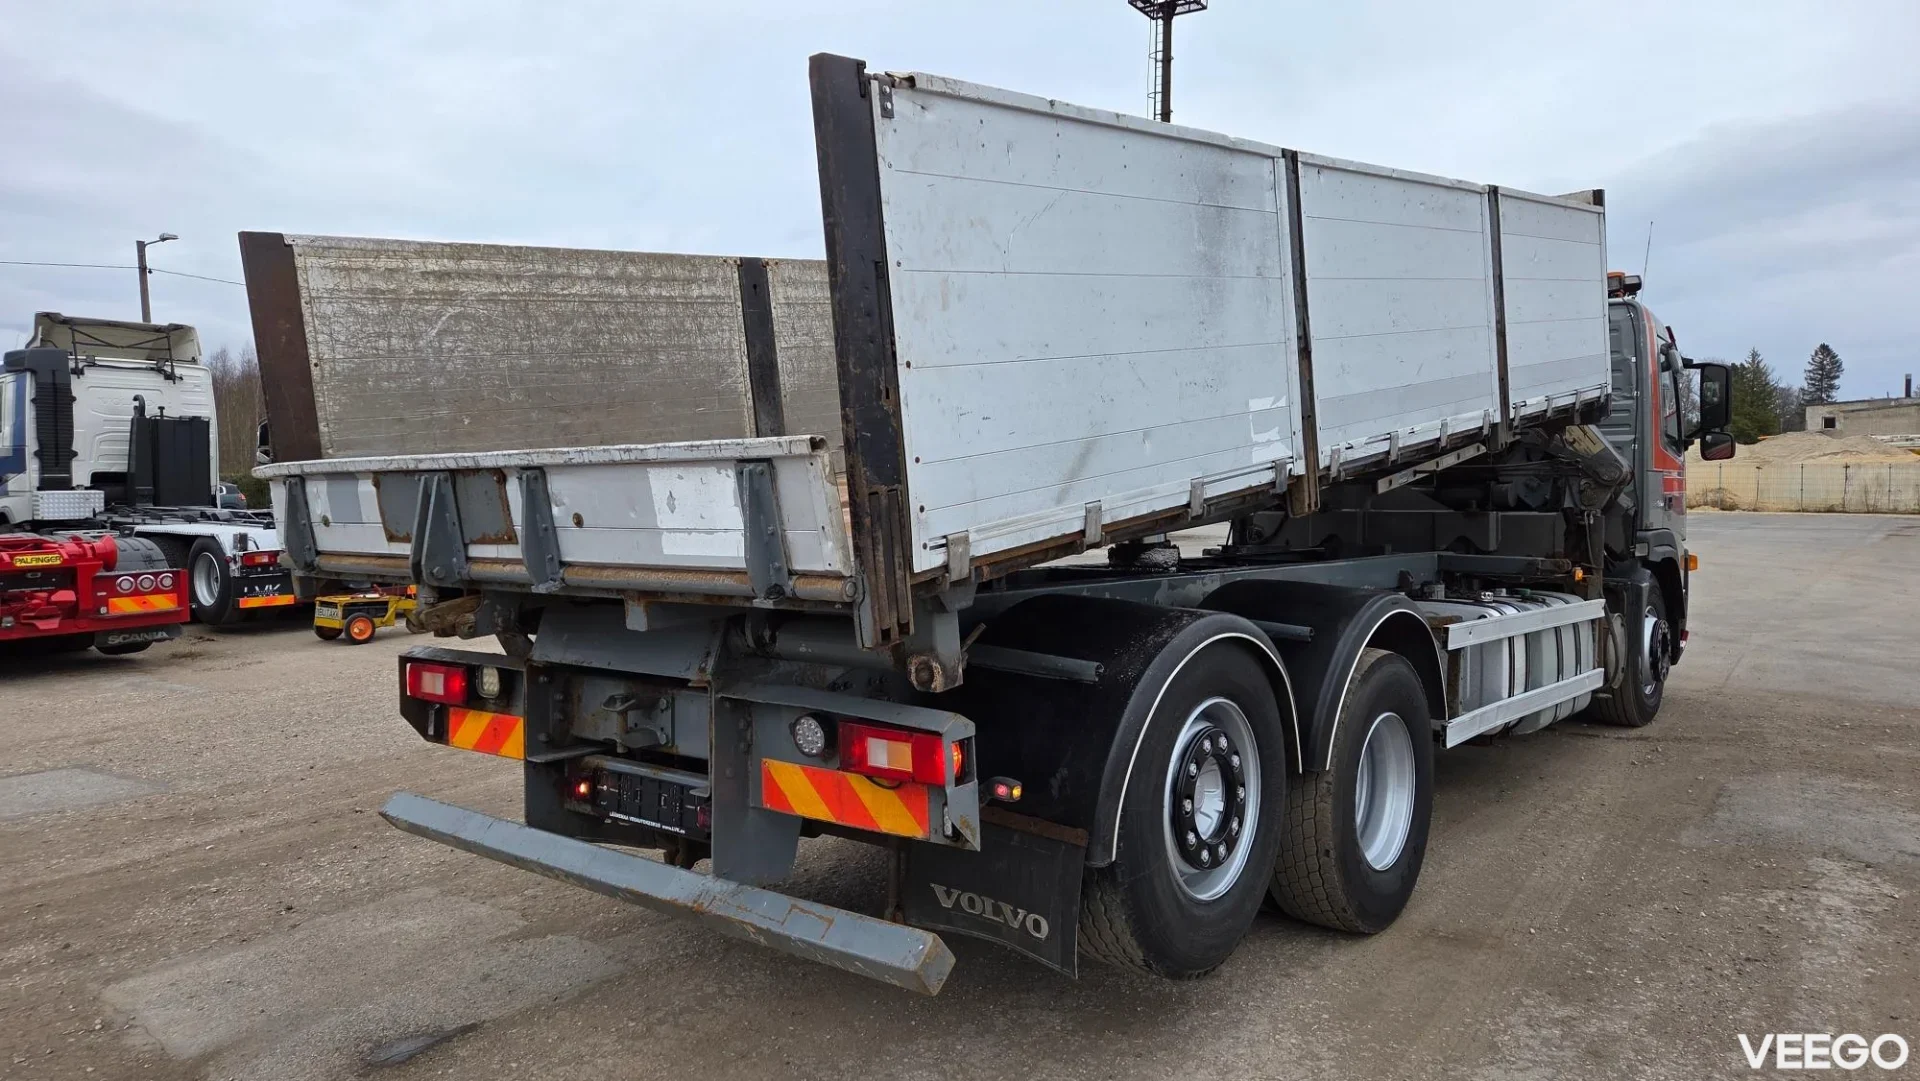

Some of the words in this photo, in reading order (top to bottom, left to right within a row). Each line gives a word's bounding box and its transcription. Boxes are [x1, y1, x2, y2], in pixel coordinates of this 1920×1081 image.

[15, 555, 62, 565] PALFINGER
[107, 632, 169, 644] SCANIA
[930, 883, 1049, 938] VOLVO
